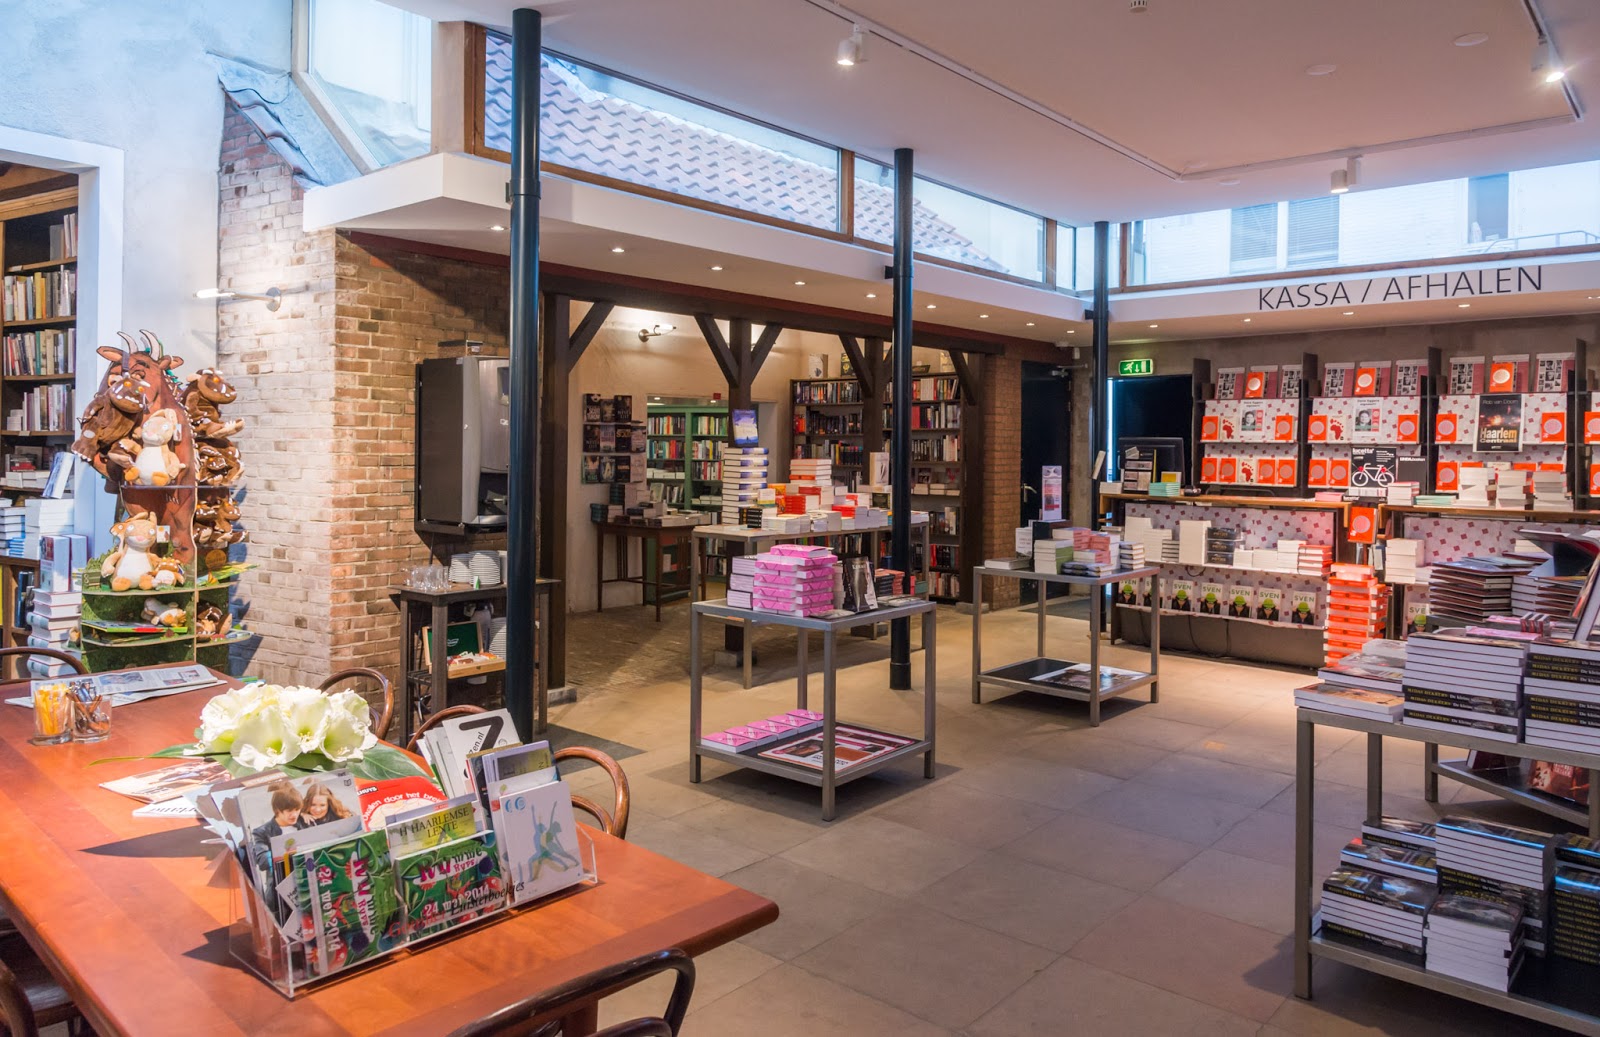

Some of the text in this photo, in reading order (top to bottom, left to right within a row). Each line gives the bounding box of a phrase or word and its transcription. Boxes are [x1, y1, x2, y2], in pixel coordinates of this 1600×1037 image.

[1258, 265, 1542, 310] KASSA / AFHALEN
[1480, 427, 1518, 438] Haarlem
[384, 792, 404, 803] door
[411, 807, 470, 833] HAARLEMSE
[427, 820, 459, 838] LENTE
[320, 868, 333, 887] 24
[424, 902, 439, 916] 24
[464, 885, 490, 900] 2014
[325, 917, 341, 952] 2014
